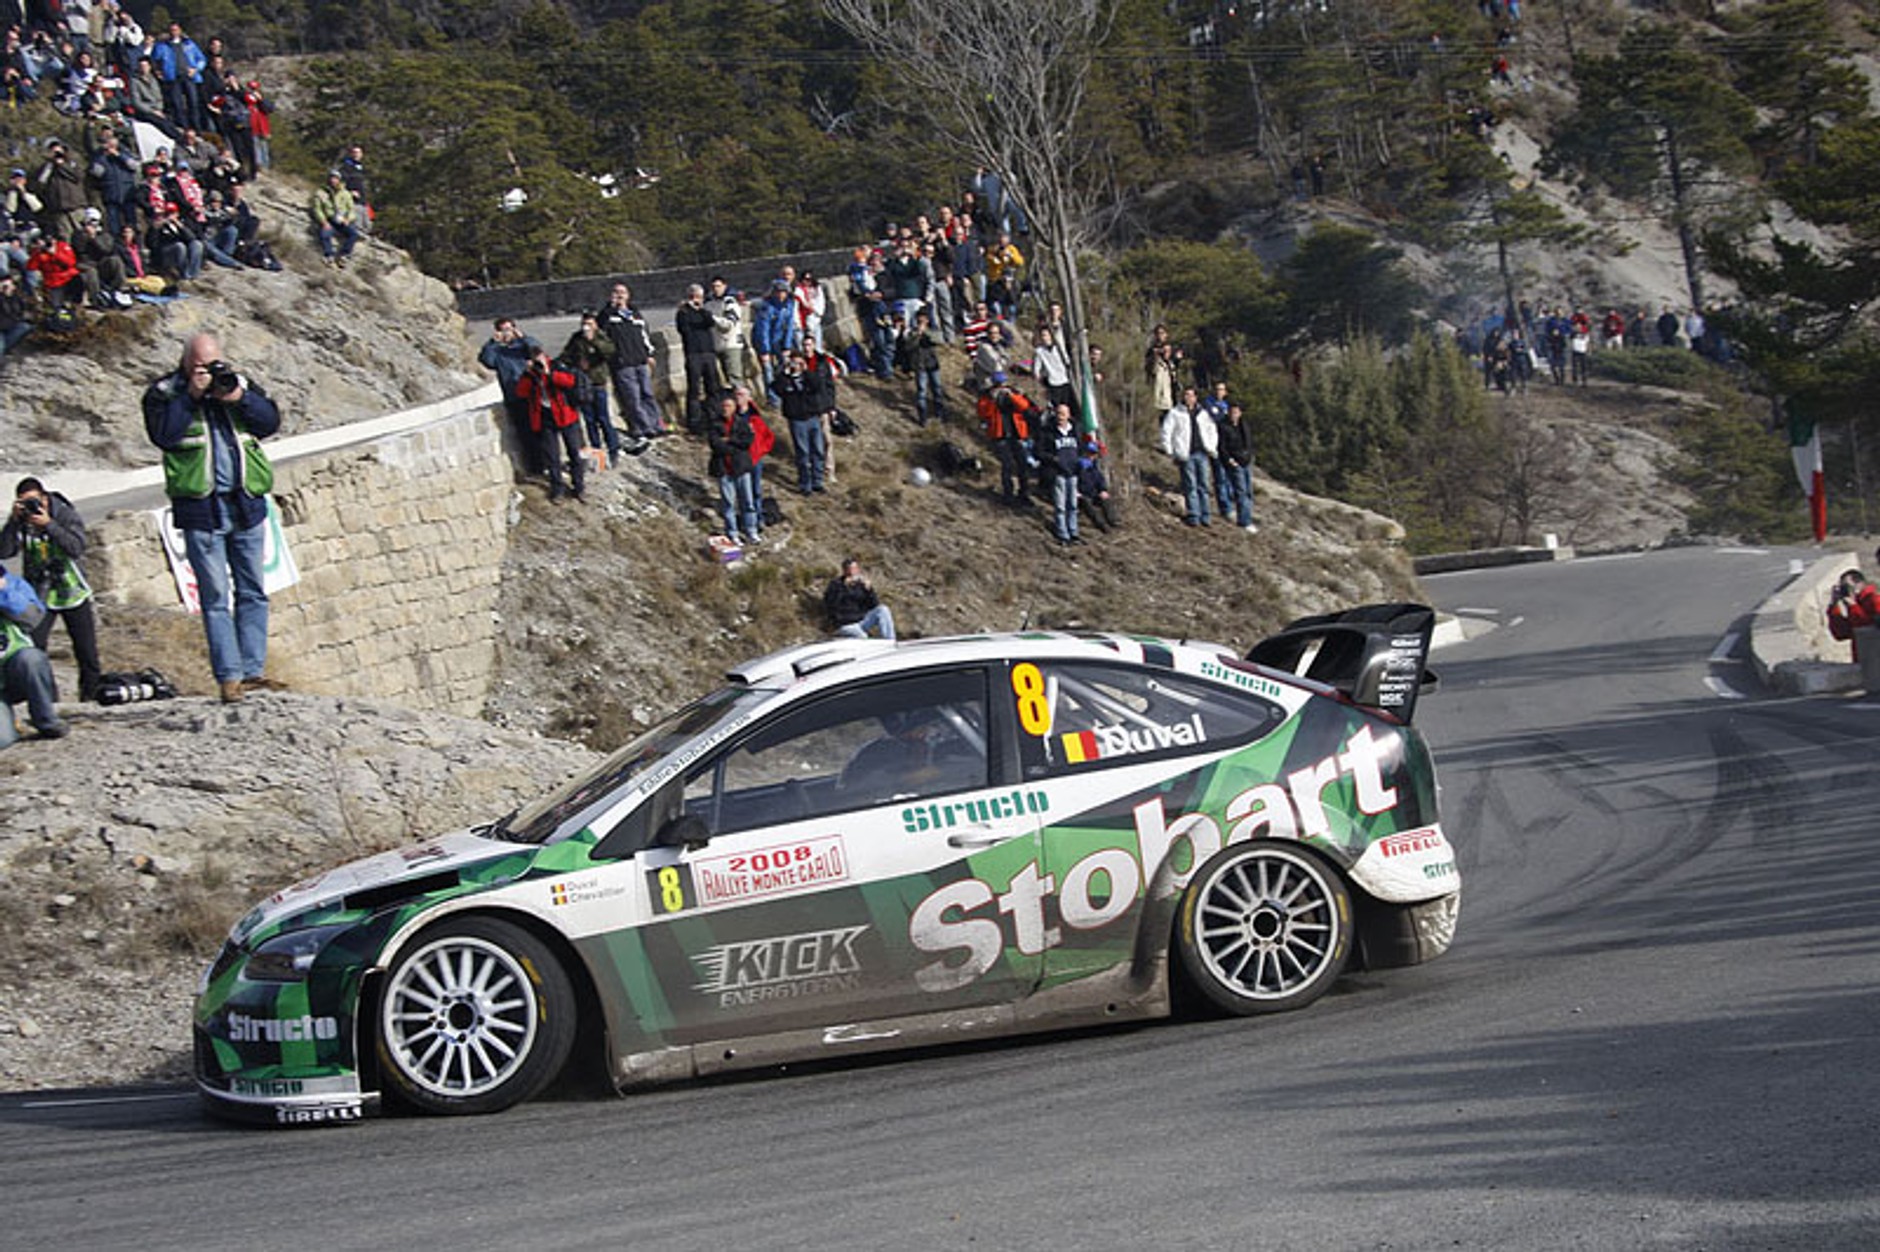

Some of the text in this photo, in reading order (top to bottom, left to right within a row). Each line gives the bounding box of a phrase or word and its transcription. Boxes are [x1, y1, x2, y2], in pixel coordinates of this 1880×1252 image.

[1010, 661, 1052, 738] 8
[1101, 713, 1208, 755] Duval
[728, 846, 813, 873] 2008
[909, 724, 1398, 994] Stobart
[657, 865, 685, 913] 8
[702, 869, 750, 901] RALLYE
[718, 924, 870, 988] KICK
